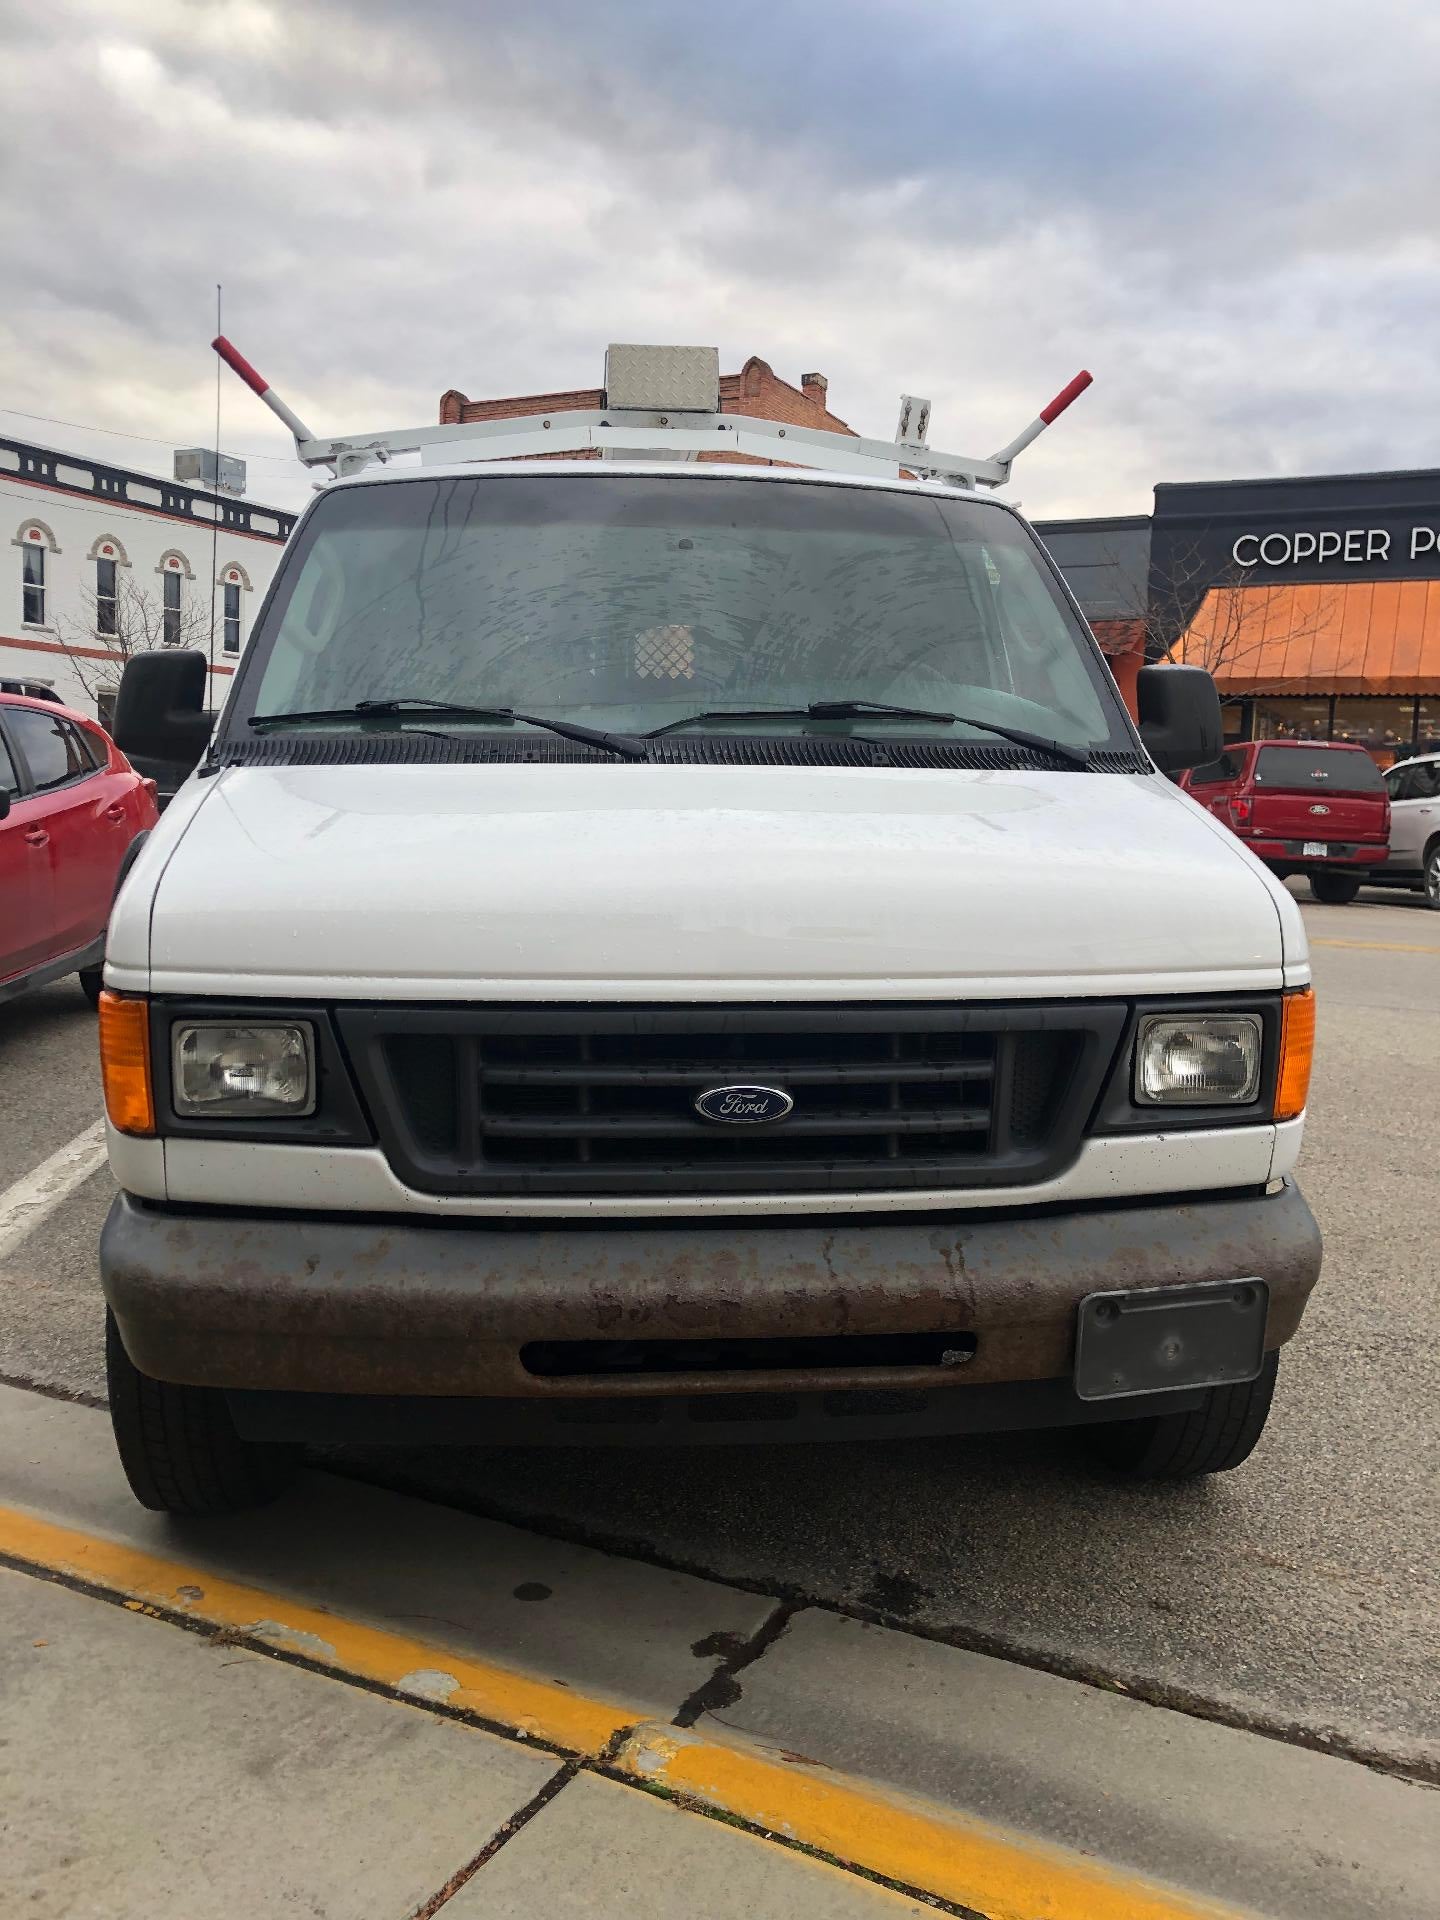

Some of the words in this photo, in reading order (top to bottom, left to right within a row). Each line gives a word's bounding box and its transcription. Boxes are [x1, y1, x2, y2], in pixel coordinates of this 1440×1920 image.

[1232, 529, 1391, 567] COPPER
[1410, 526, 1440, 560] P
[719, 1093, 769, 1114] Ford
